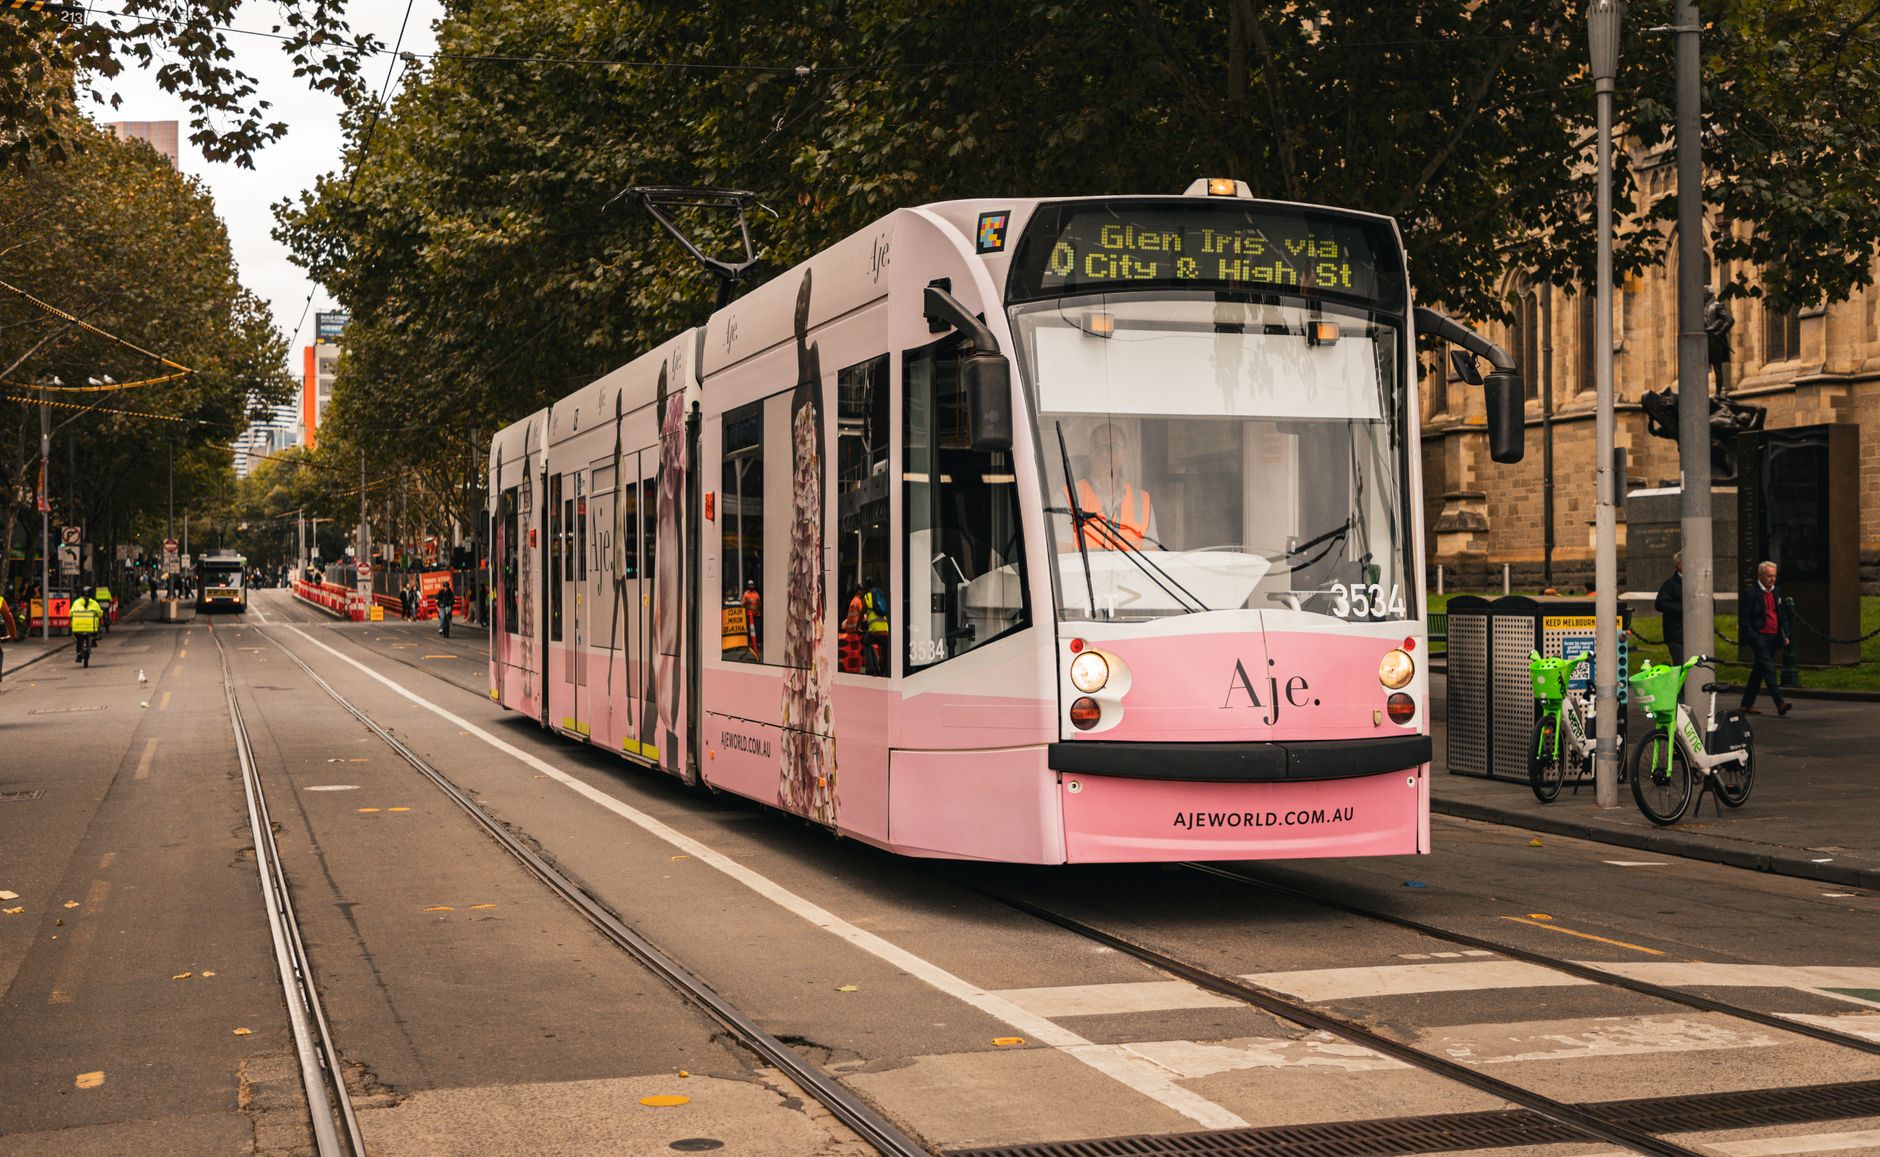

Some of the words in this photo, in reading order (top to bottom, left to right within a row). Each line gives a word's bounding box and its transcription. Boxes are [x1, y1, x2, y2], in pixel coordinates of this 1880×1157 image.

[61, 10, 83, 24] 213
[1101, 224, 1182, 252] Glen
[1201, 228, 1265, 255] Iris
[1285, 233, 1338, 258] via
[1085, 253, 1157, 280] City
[1176, 256, 1200, 280] &
[1218, 258, 1297, 286] High
[1315, 262, 1353, 288] St
[1330, 582, 1407, 618] 3534
[1545, 619, 1561, 627] KEEP
[1563, 618, 1596, 627] MELBOURN
[1218, 657, 1321, 727] Aje.
[720, 730, 771, 758] AJEWORLD.COM.AU
[1173, 806, 1355, 831] AJEWORLD.COM.AU
